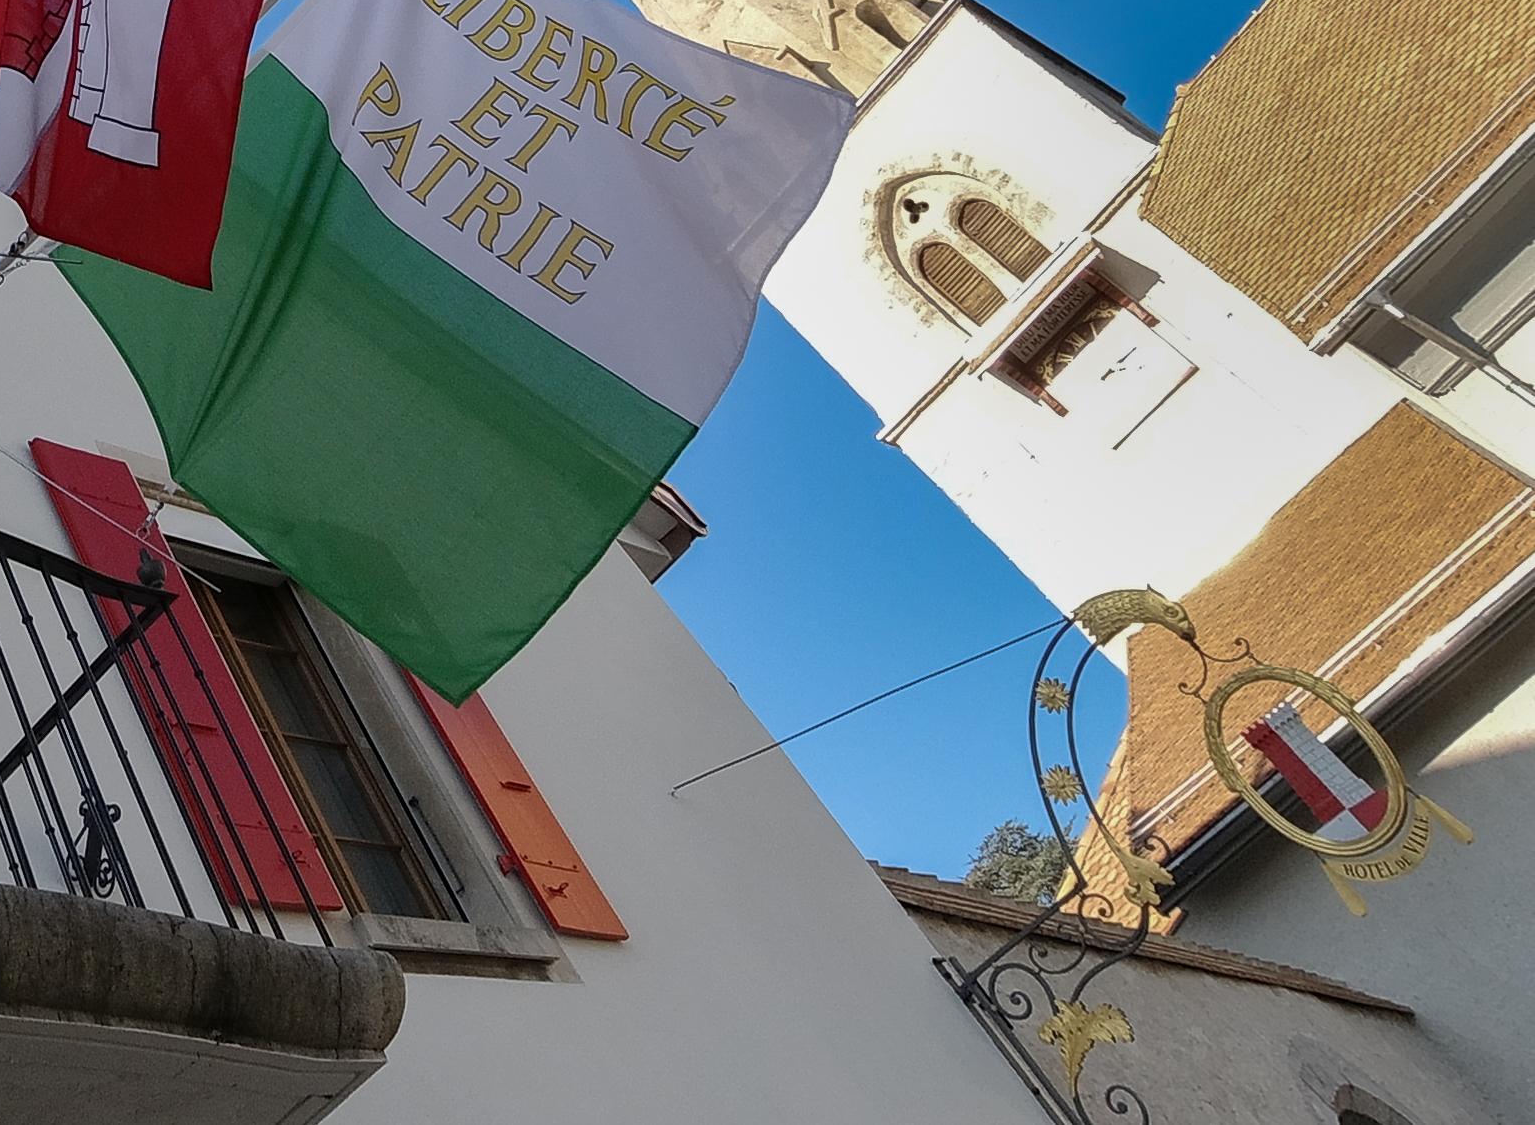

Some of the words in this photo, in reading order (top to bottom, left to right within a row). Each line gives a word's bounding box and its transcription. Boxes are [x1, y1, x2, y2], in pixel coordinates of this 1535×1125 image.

[450, 77, 579, 173] ET
[352, 62, 614, 304] PATRIE
[1014, 329, 1034, 349] DIEU
[1045, 304, 1061, 318] MA
[1058, 282, 1080, 305] TOUR
[1020, 345, 1033, 357] ET
[1030, 334, 1046, 346] MA
[1042, 290, 1090, 334] FORTERESSE
[1395, 856, 1412, 871] DE
[1403, 812, 1430, 854] VILLE
[1342, 860, 1398, 880] HOTEL
